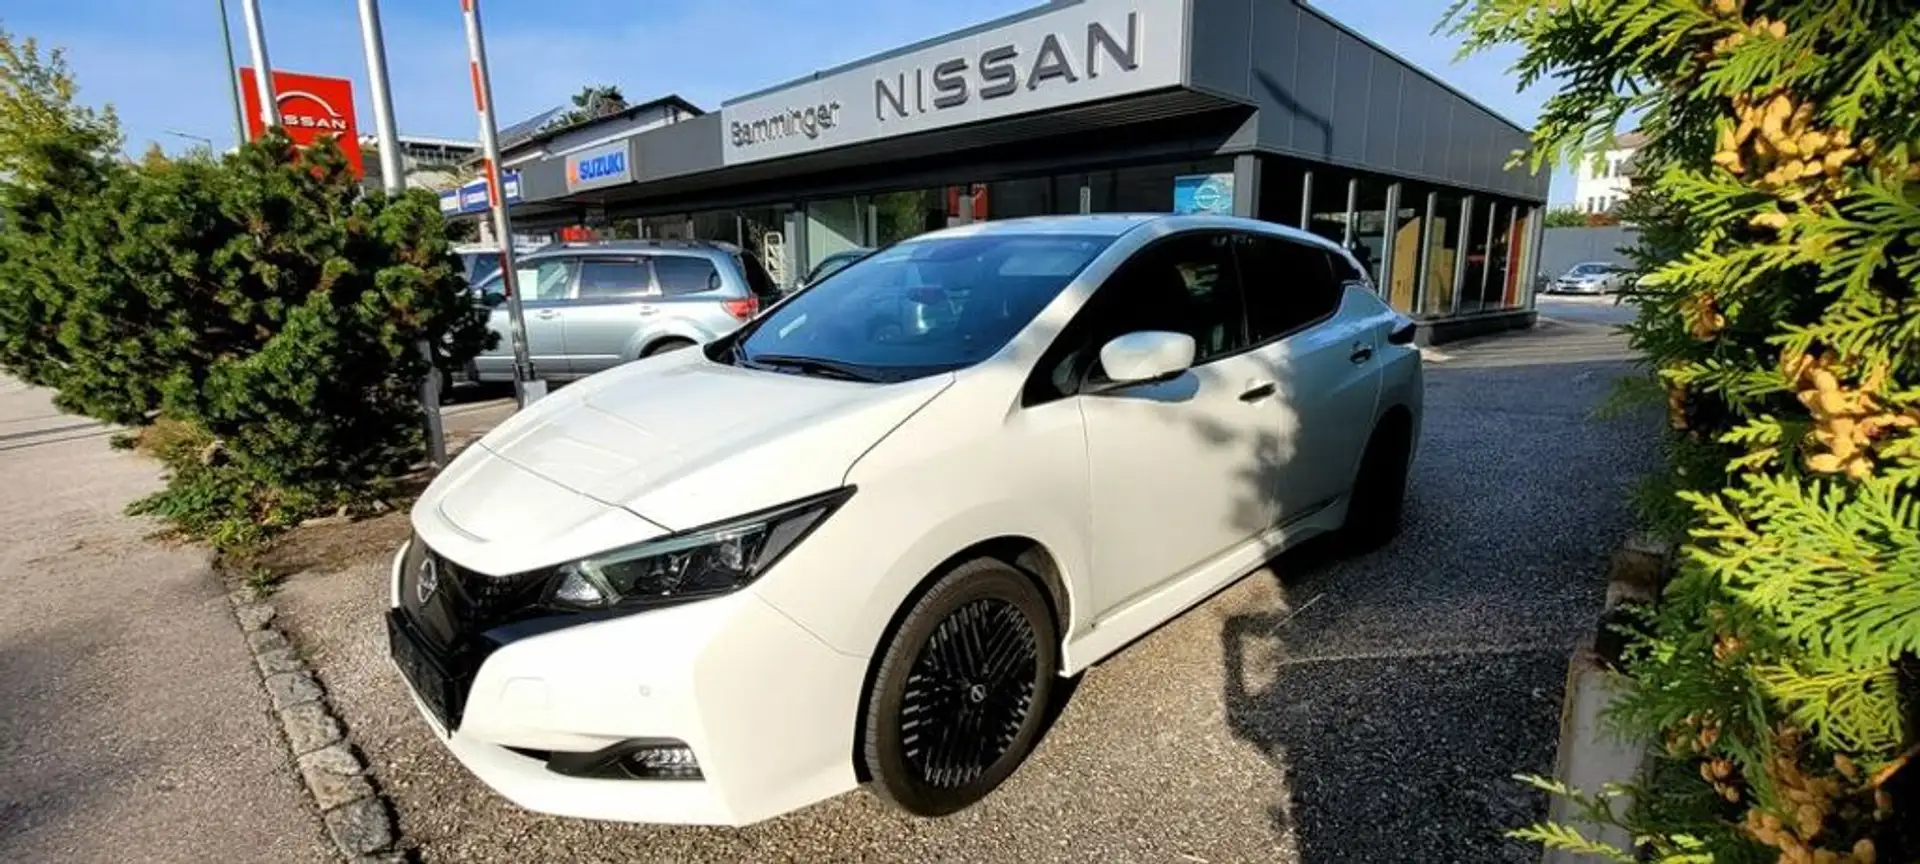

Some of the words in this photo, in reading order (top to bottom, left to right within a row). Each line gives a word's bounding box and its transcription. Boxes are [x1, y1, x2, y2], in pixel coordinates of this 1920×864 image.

[731, 100, 840, 147] Bamminger
[874, 11, 1139, 121] NISSAN
[260, 112, 347, 130] SSAN
[579, 151, 626, 181] SUZUKI
